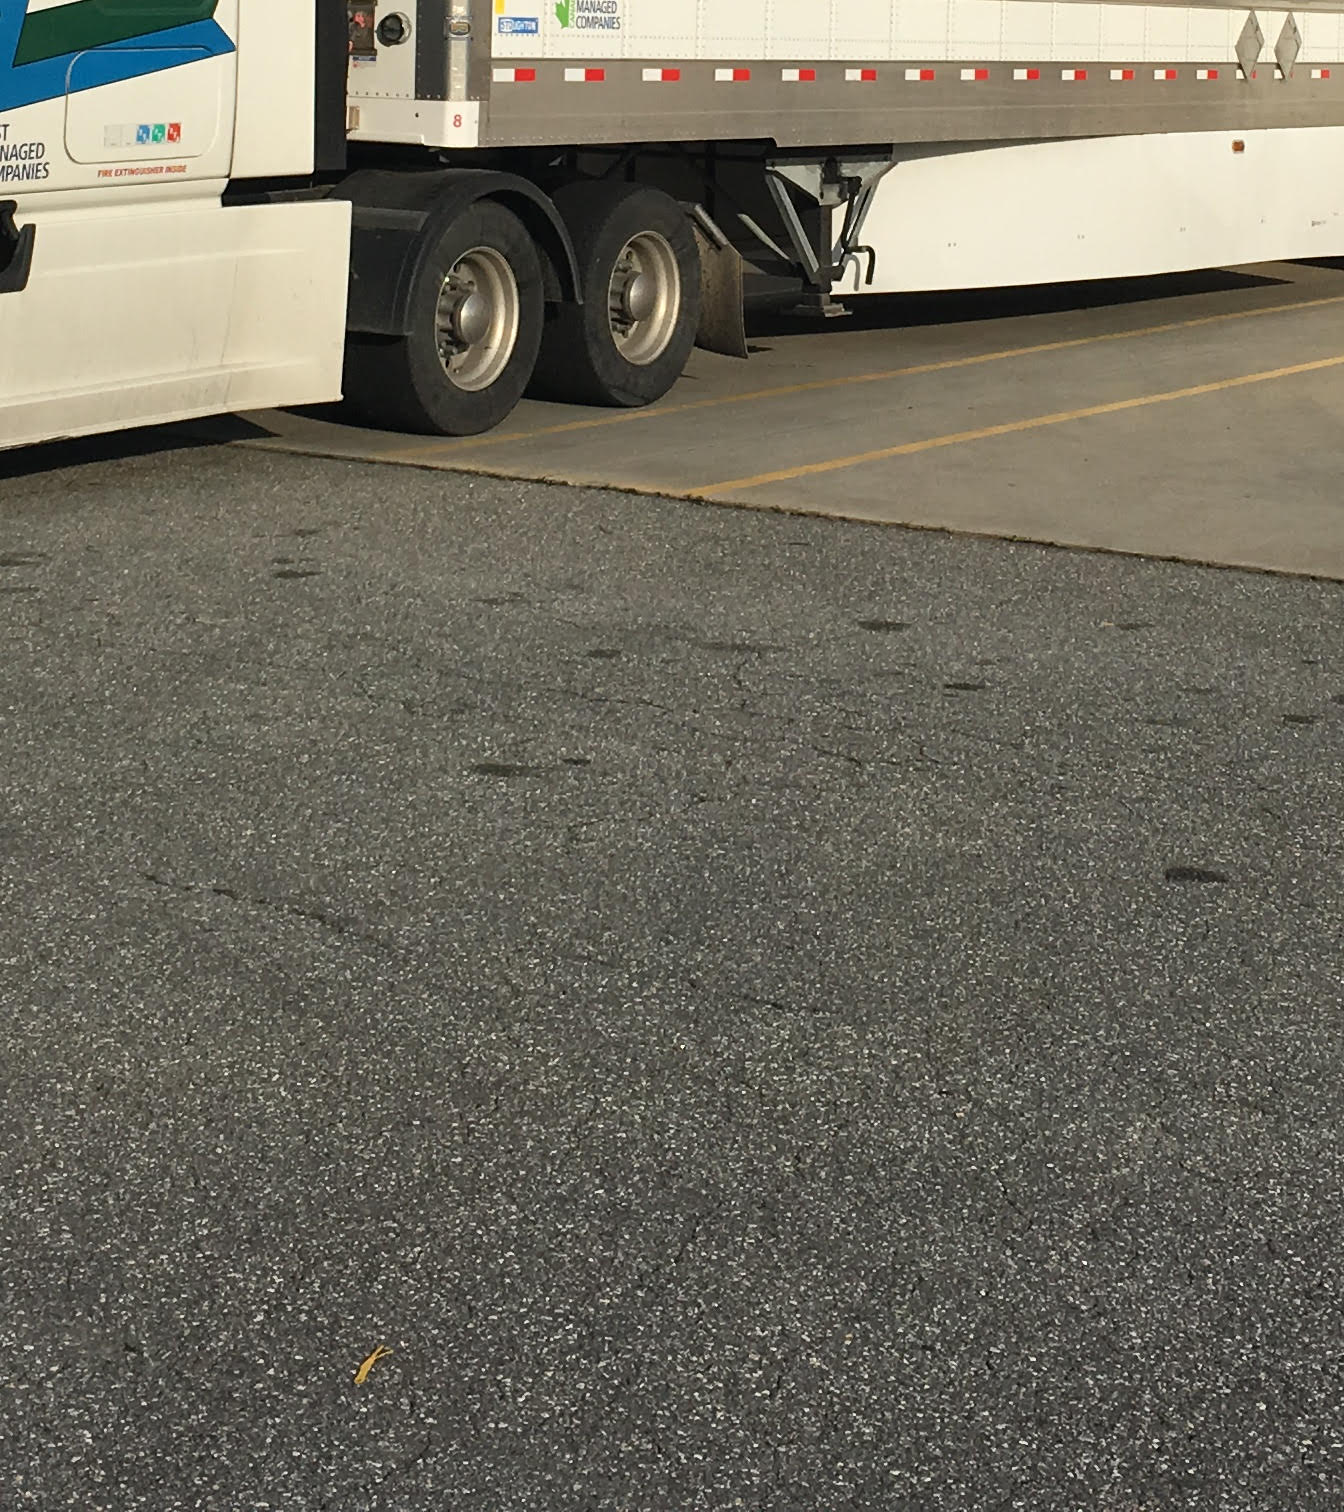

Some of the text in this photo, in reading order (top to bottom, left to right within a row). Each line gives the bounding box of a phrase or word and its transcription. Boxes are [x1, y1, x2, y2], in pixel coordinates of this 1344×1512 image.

[576, 0, 617, 14] MANAGED
[576, 15, 621, 30] COMPANIES
[453, 114, 462, 128] 8
[97, 169, 113, 178] FIRE
[164, 164, 187, 174] INSIDE
